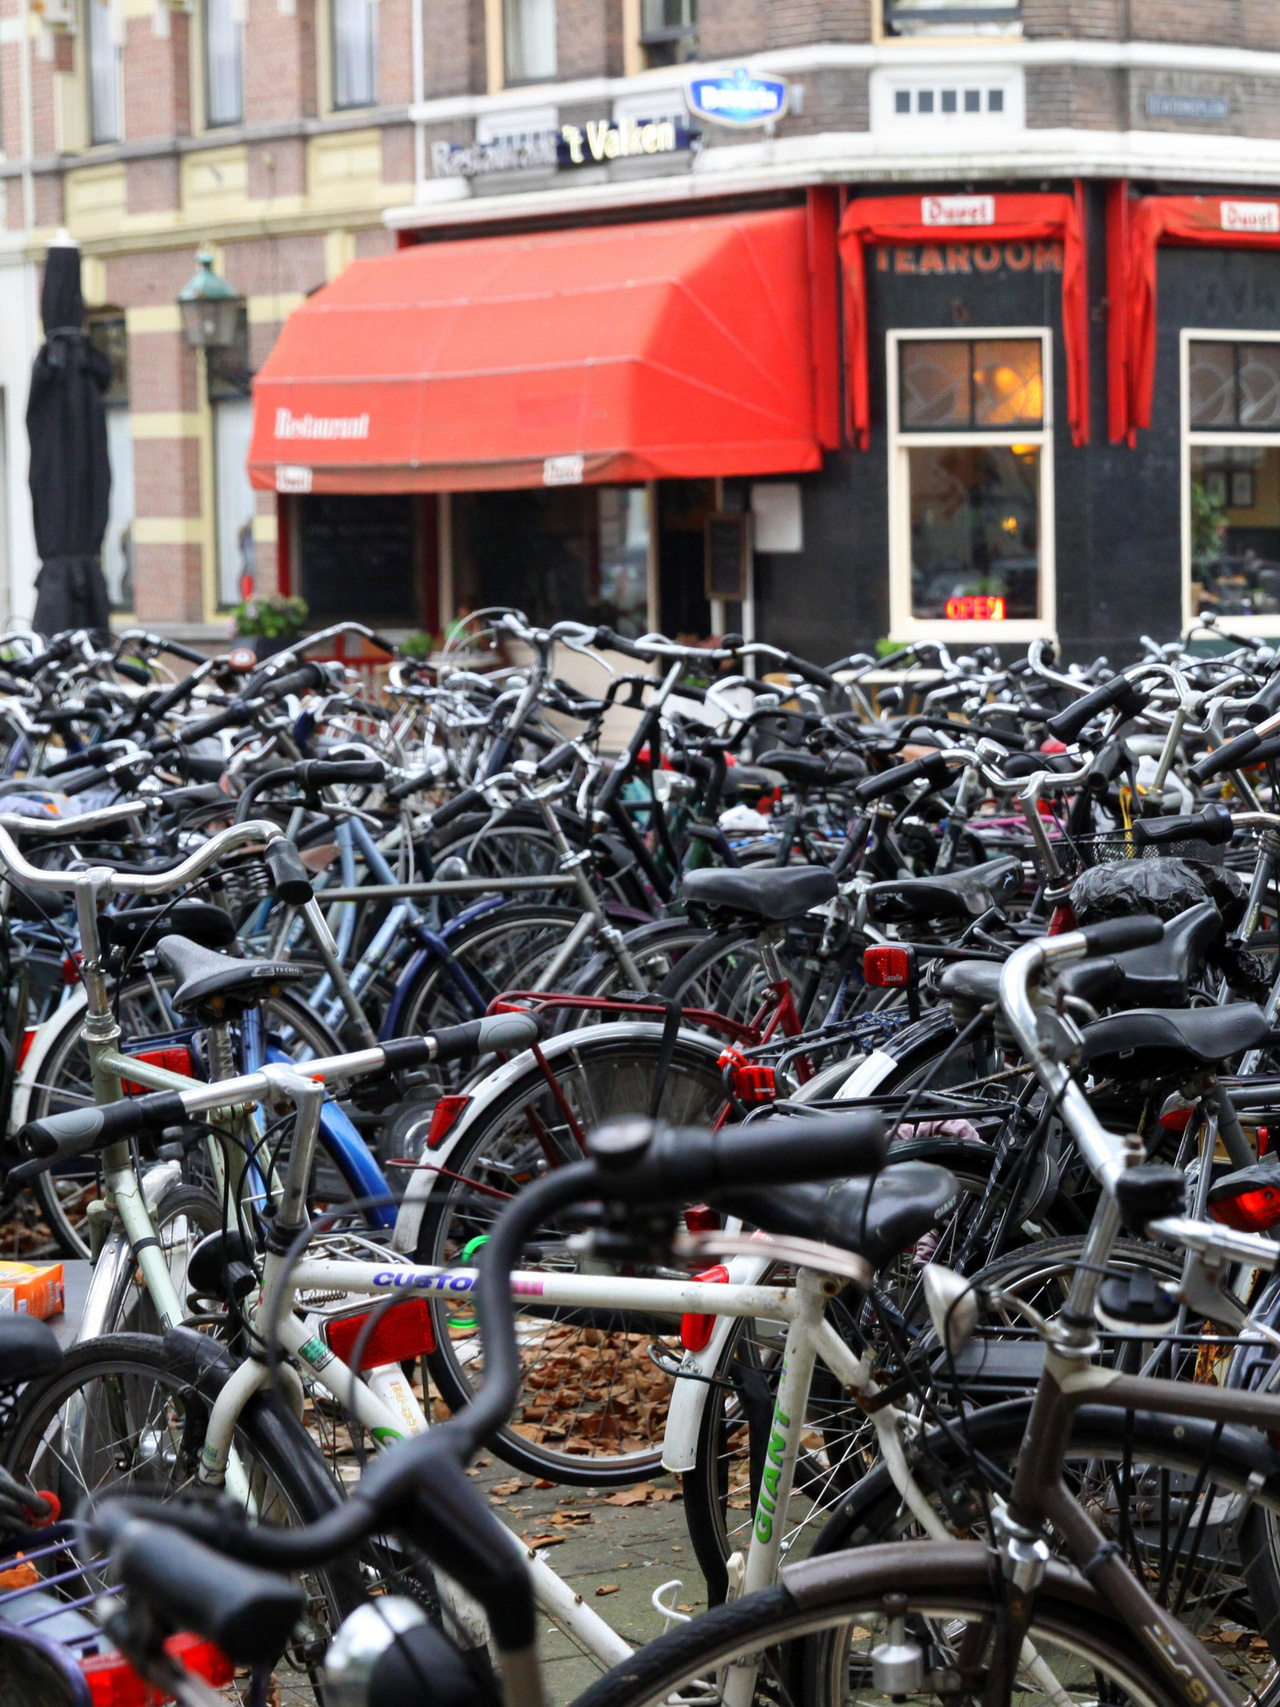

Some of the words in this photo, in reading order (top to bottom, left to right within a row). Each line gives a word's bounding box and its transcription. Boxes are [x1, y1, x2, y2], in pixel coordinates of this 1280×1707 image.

[586, 118, 676, 161] Valken
[930, 198, 986, 220] Duvel
[1227, 205, 1273, 225] Duvel
[275, 408, 369, 439] Restaurant
[946, 596, 1006, 620] OPEN
[883, 974, 903, 982] Gazelle
[934, 1195, 956, 1219] GIANT
[373, 1271, 477, 1291] CUSTO
[755, 1398, 790, 1544] GIANT
